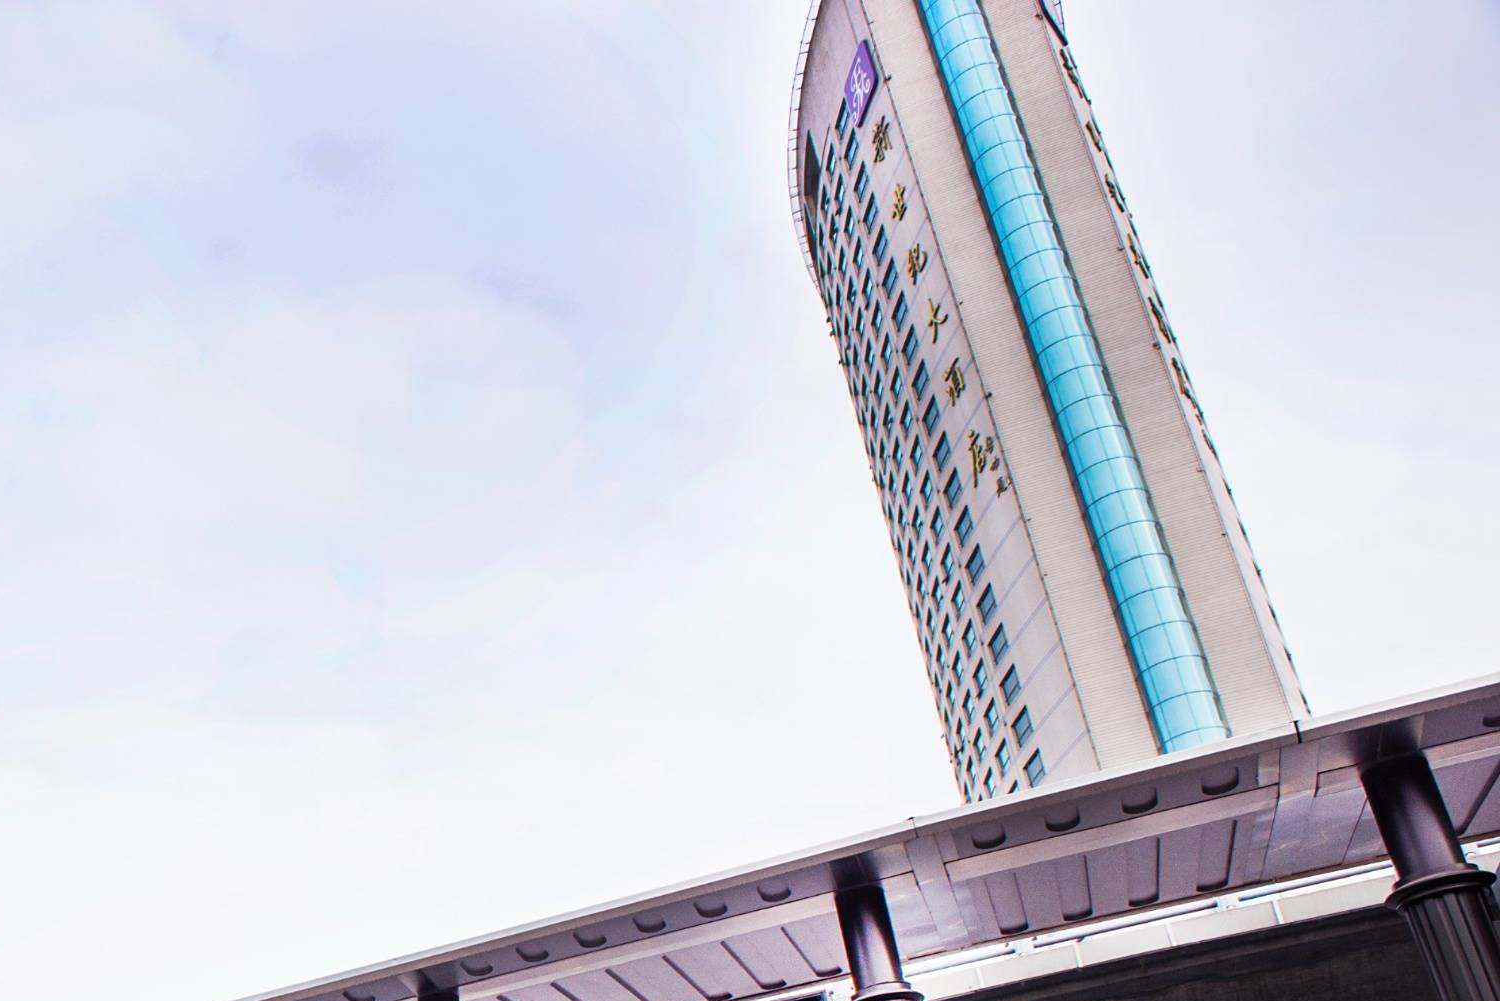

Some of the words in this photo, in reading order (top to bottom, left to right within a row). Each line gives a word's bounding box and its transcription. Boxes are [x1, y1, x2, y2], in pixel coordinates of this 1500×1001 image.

[871, 114, 987, 488] 新世纪大酒店
